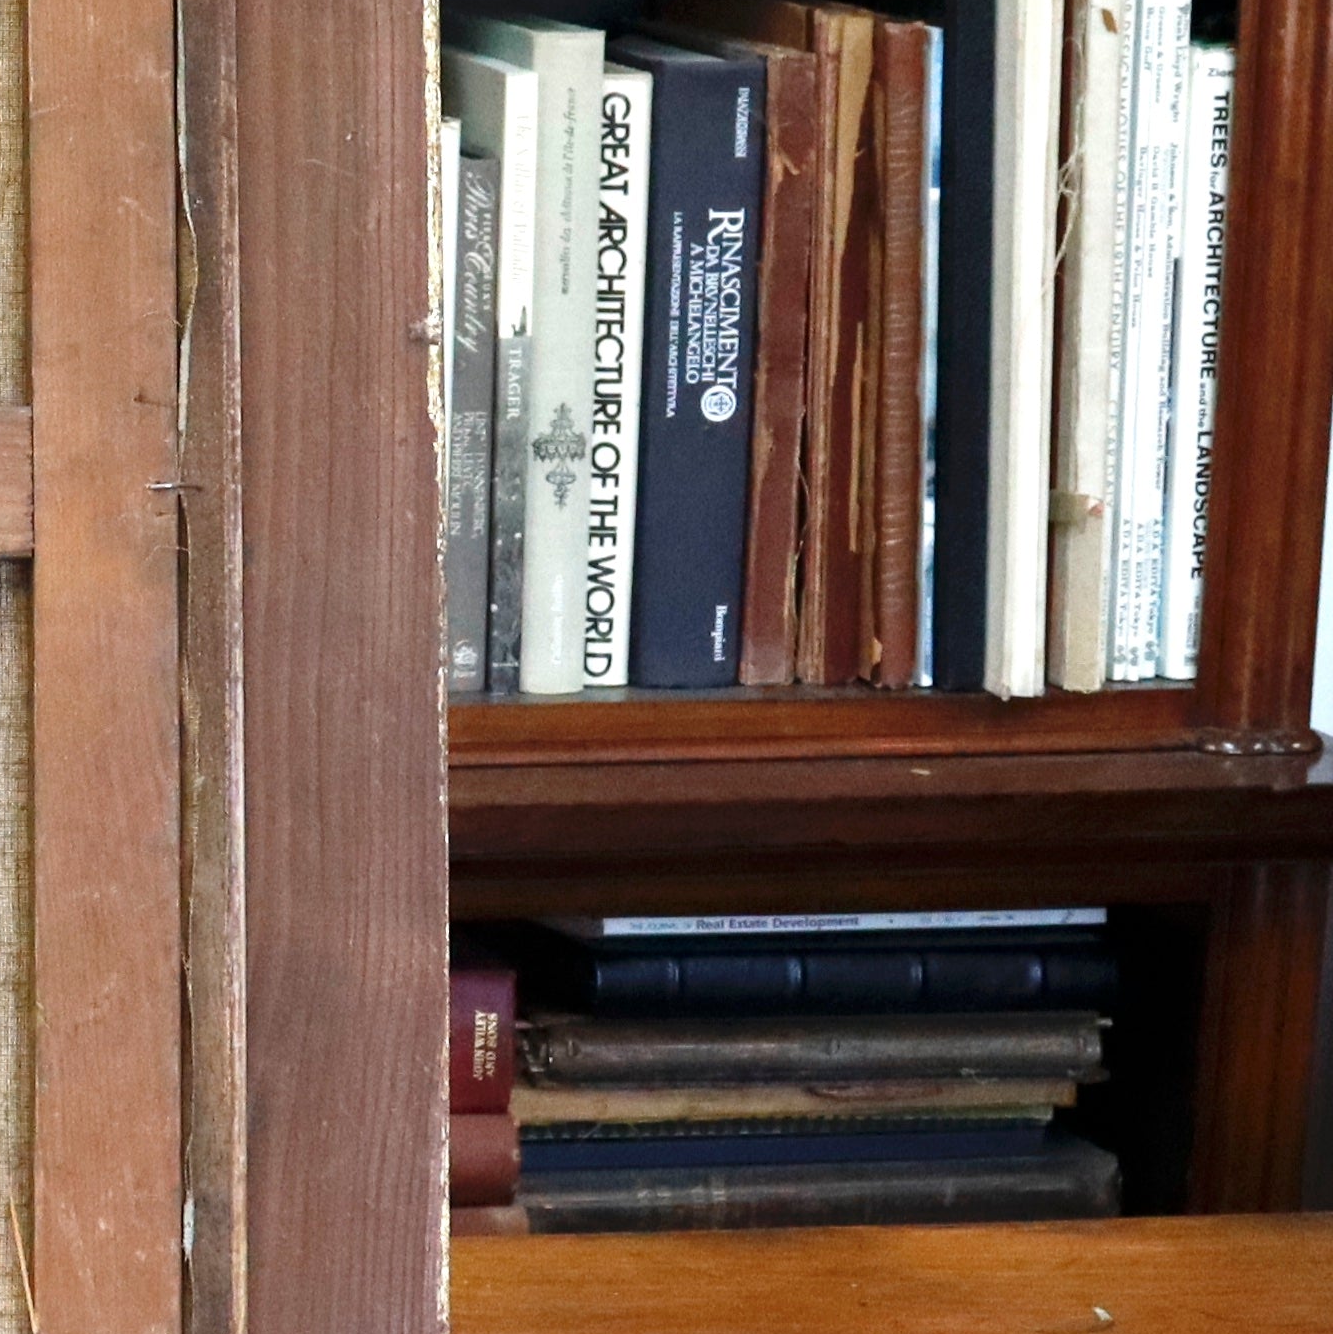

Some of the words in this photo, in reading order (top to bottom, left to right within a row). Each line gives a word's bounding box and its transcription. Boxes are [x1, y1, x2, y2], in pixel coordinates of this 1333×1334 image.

[601, 92, 631, 196] GREAT
[1210, 91, 1230, 167] TREES
[464, 170, 495, 240] Paris
[1210, 170, 1219, 189] for
[705, 245, 721, 268] DA
[1200, 191, 1225, 378] ARCHITECTURE
[592, 202, 628, 427] ARCHITECTURE
[685, 261, 704, 385] MICHELANGELO
[506, 347, 522, 420] TRAGER
[1198, 381, 1207, 405] and
[1197, 406, 1206, 428] the
[591, 436, 621, 485] OF
[588, 489, 618, 549] THE
[1191, 430, 1213, 579] LANDSCAPE
[584, 559, 615, 679] WORLD
[714, 604, 727, 662] Bompiani
[696, 918, 725, 929] Real
[728, 918, 769, 929] Estate
[772, 916, 860, 929] Development
[486, 1012, 498, 1048] SONS
[485, 1050, 497, 1076] AND
